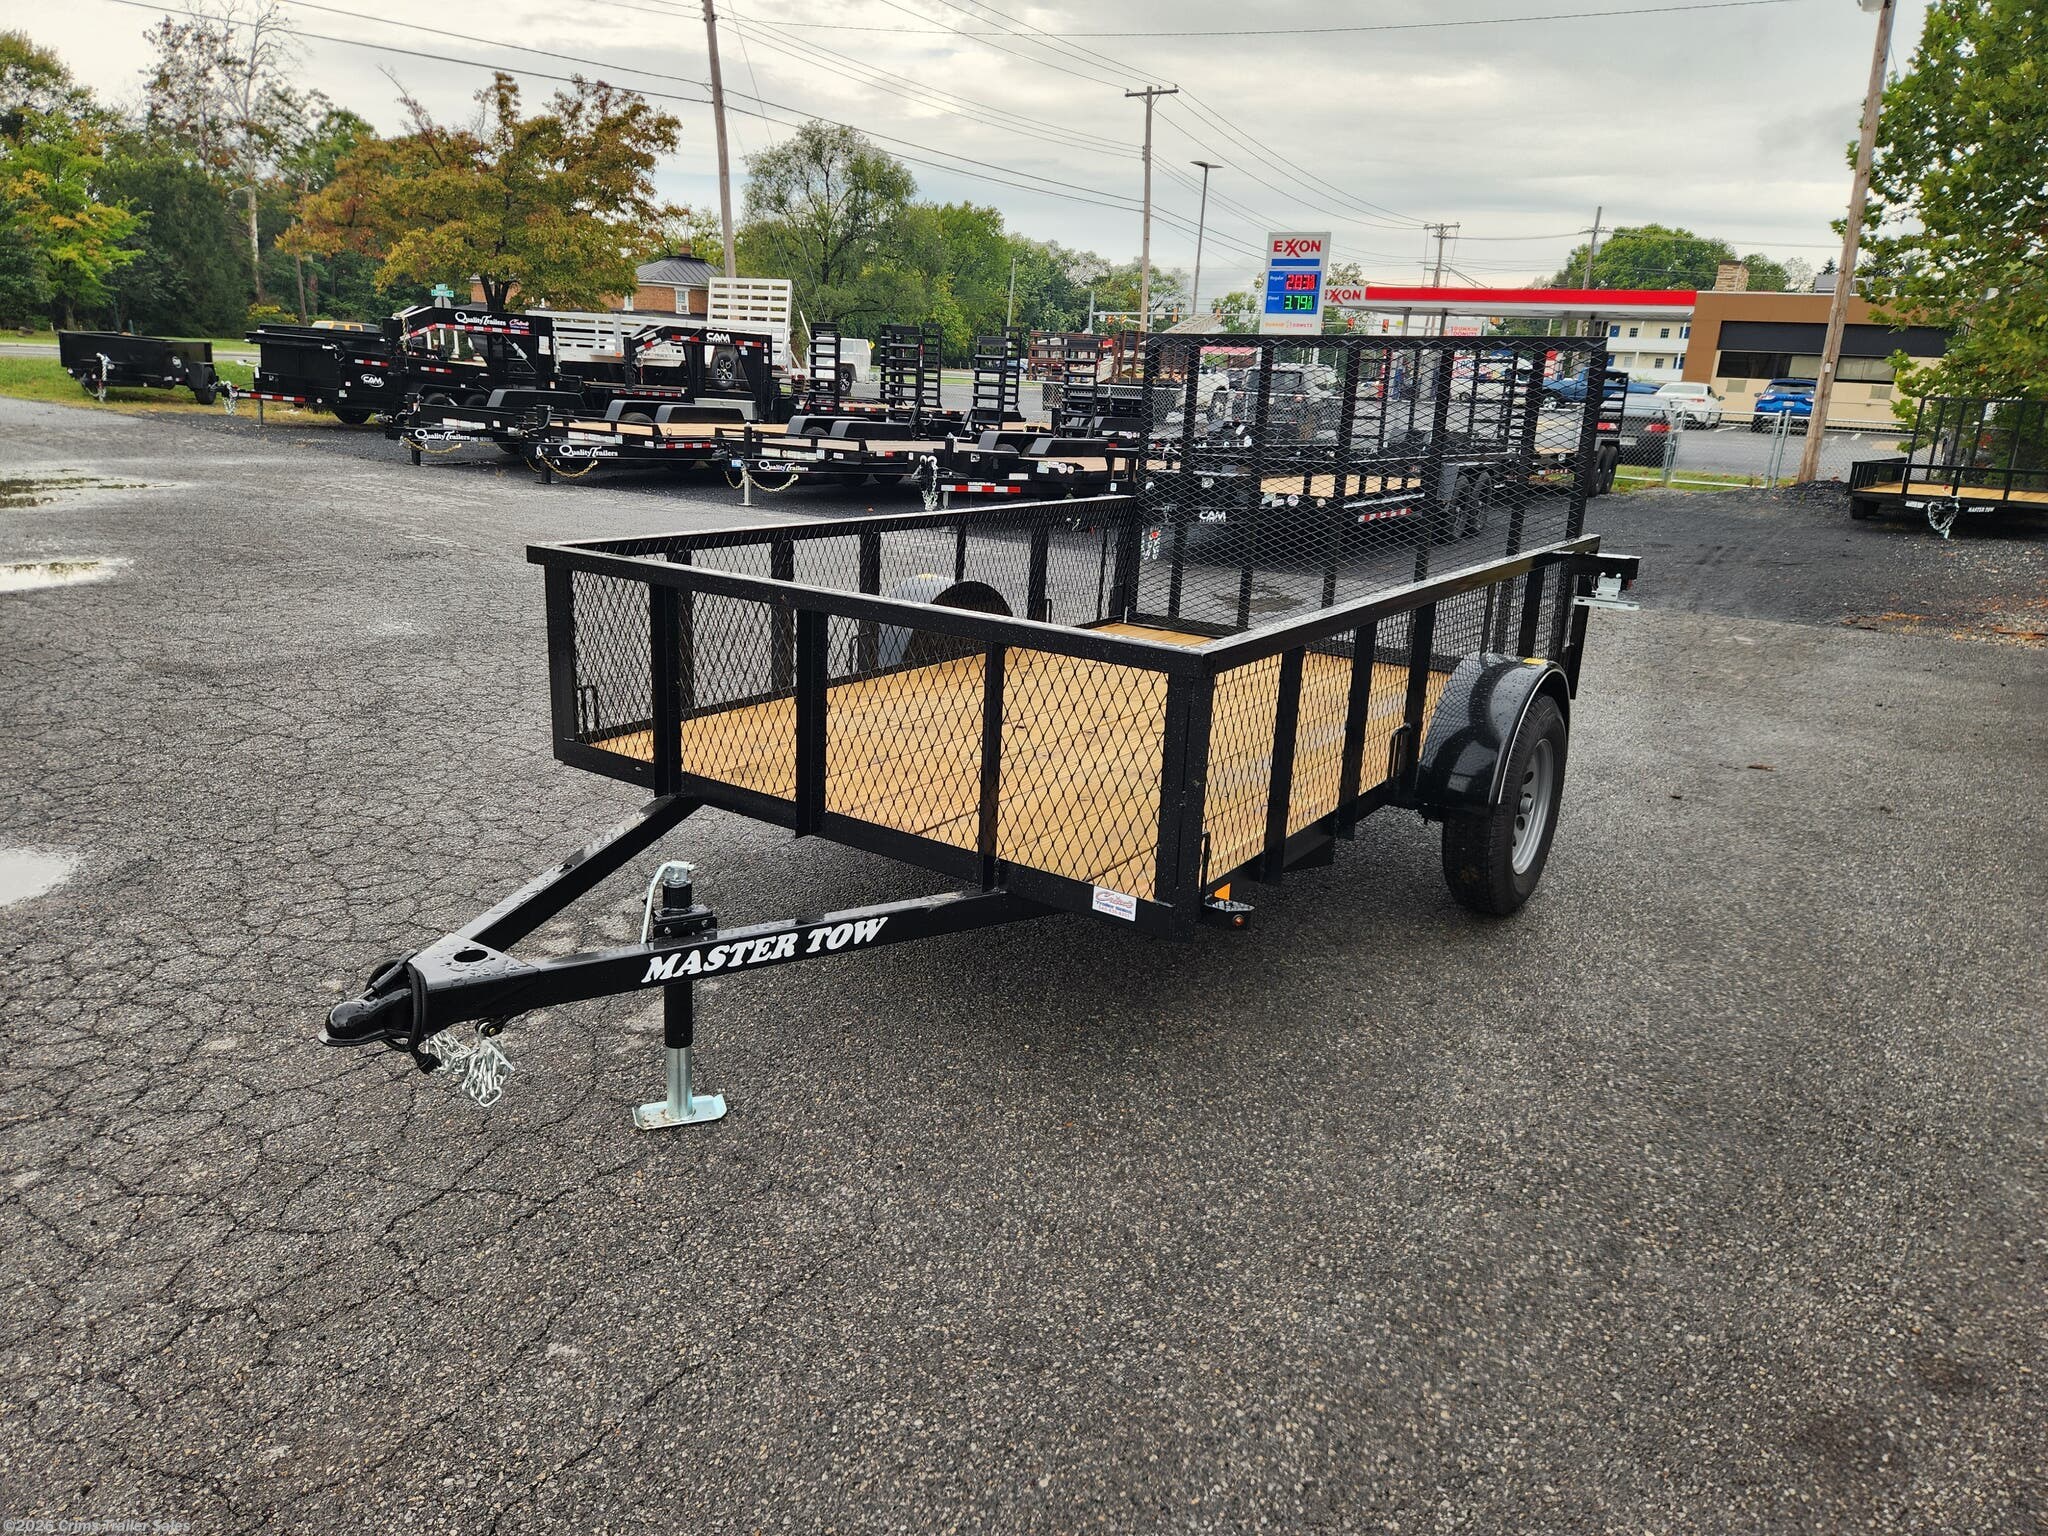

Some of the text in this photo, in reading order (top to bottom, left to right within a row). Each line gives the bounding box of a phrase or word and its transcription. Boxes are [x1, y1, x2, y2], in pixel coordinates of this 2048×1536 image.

[1273, 239, 1322, 257] EXXON
[706, 332, 730, 343] CAM
[1199, 510, 1226, 521] CAM
[641, 916, 889, 983] MASTER TOW
